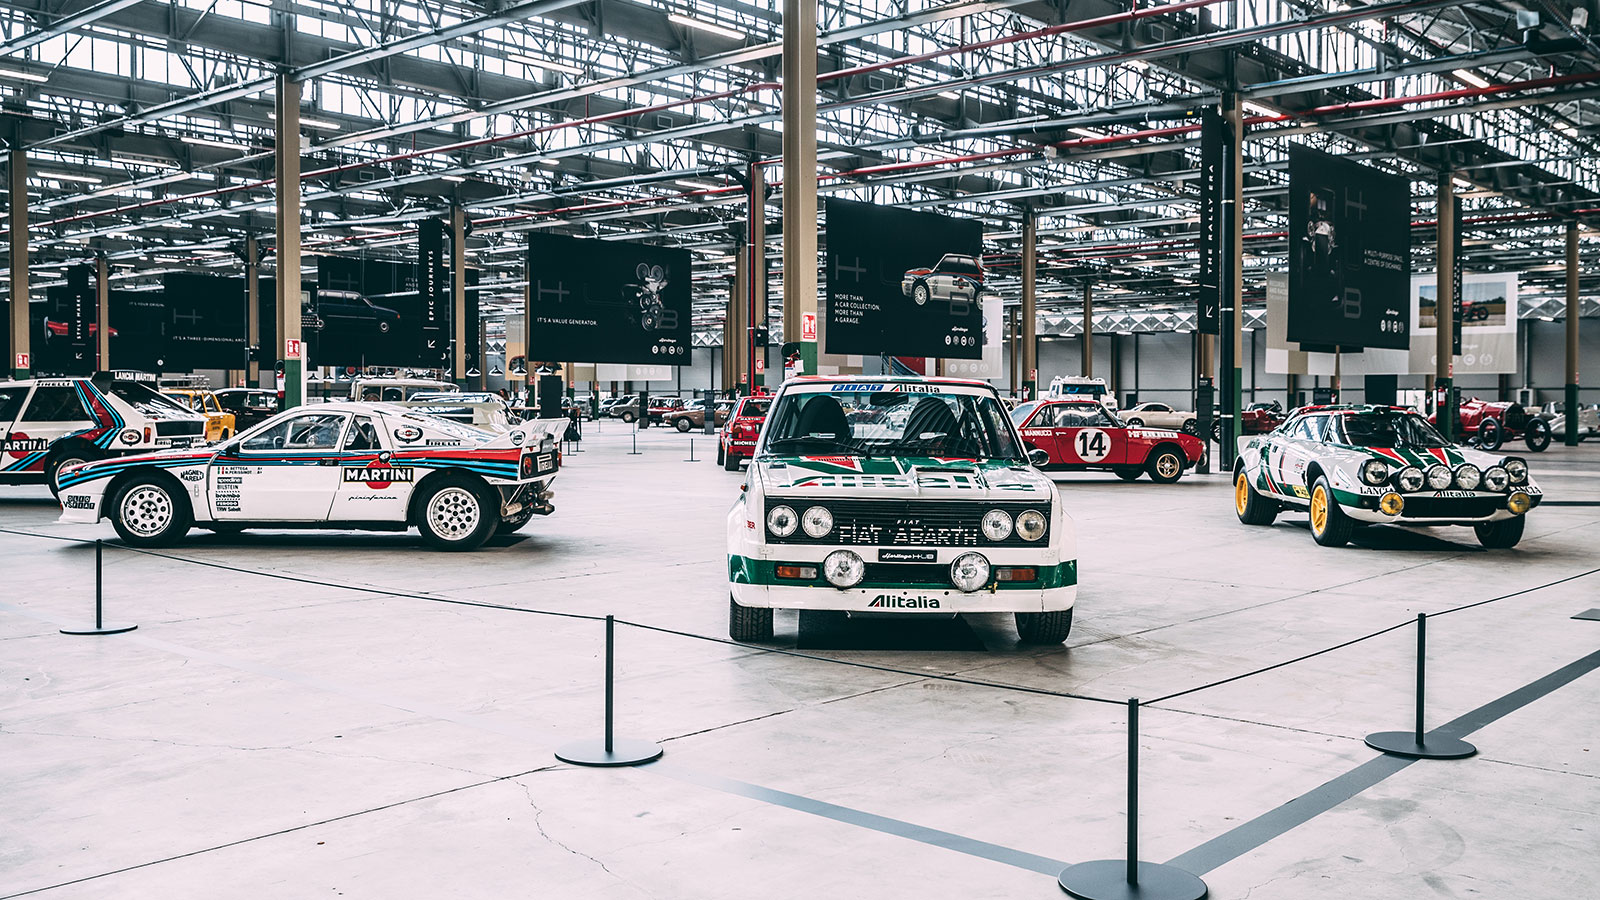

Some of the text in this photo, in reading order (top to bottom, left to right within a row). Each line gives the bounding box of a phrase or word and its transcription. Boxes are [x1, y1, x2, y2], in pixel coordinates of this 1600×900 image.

[115, 372, 156, 382] LANCIA MARTINI
[890, 384, 940, 393] Alitalia
[0, 440, 46, 450] ARTINI
[1079, 432, 1106, 457] 14
[346, 469, 411, 481] MARTINI
[839, 526, 978, 545] FIAT ABARTH
[868, 595, 940, 609] Alitalia
